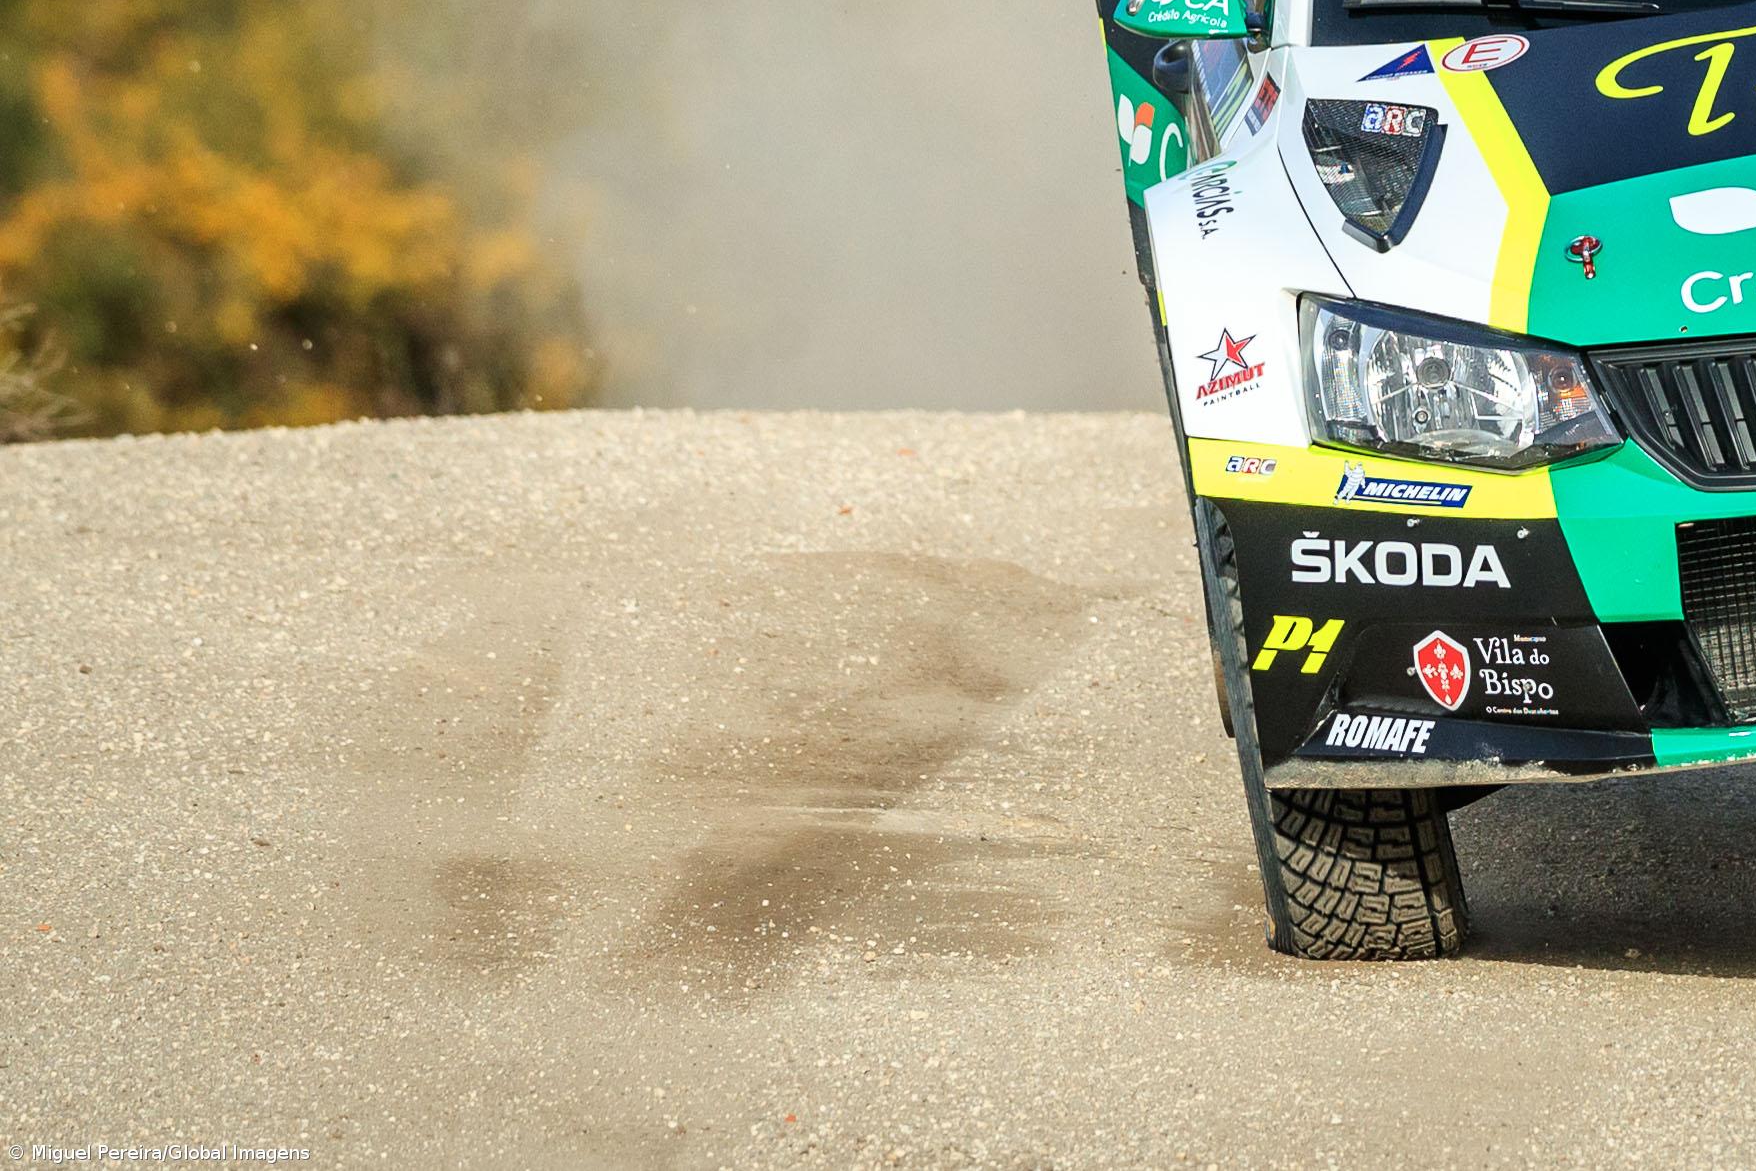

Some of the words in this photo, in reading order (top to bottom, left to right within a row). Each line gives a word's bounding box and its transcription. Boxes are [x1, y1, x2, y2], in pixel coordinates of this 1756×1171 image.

[1461, 40, 1508, 64] E
[1196, 362, 1265, 400] AZIMUT
[1203, 383, 1261, 406] PAINTBALL
[1363, 482, 1468, 502] MICHELIN
[1291, 531, 1511, 588] ŠKODA
[1252, 615, 1345, 673] P1
[1473, 636, 1525, 664] Vila
[1529, 648, 1550, 664] do
[1479, 668, 1554, 703] Bispo
[1326, 714, 1436, 754] ROMAFE
